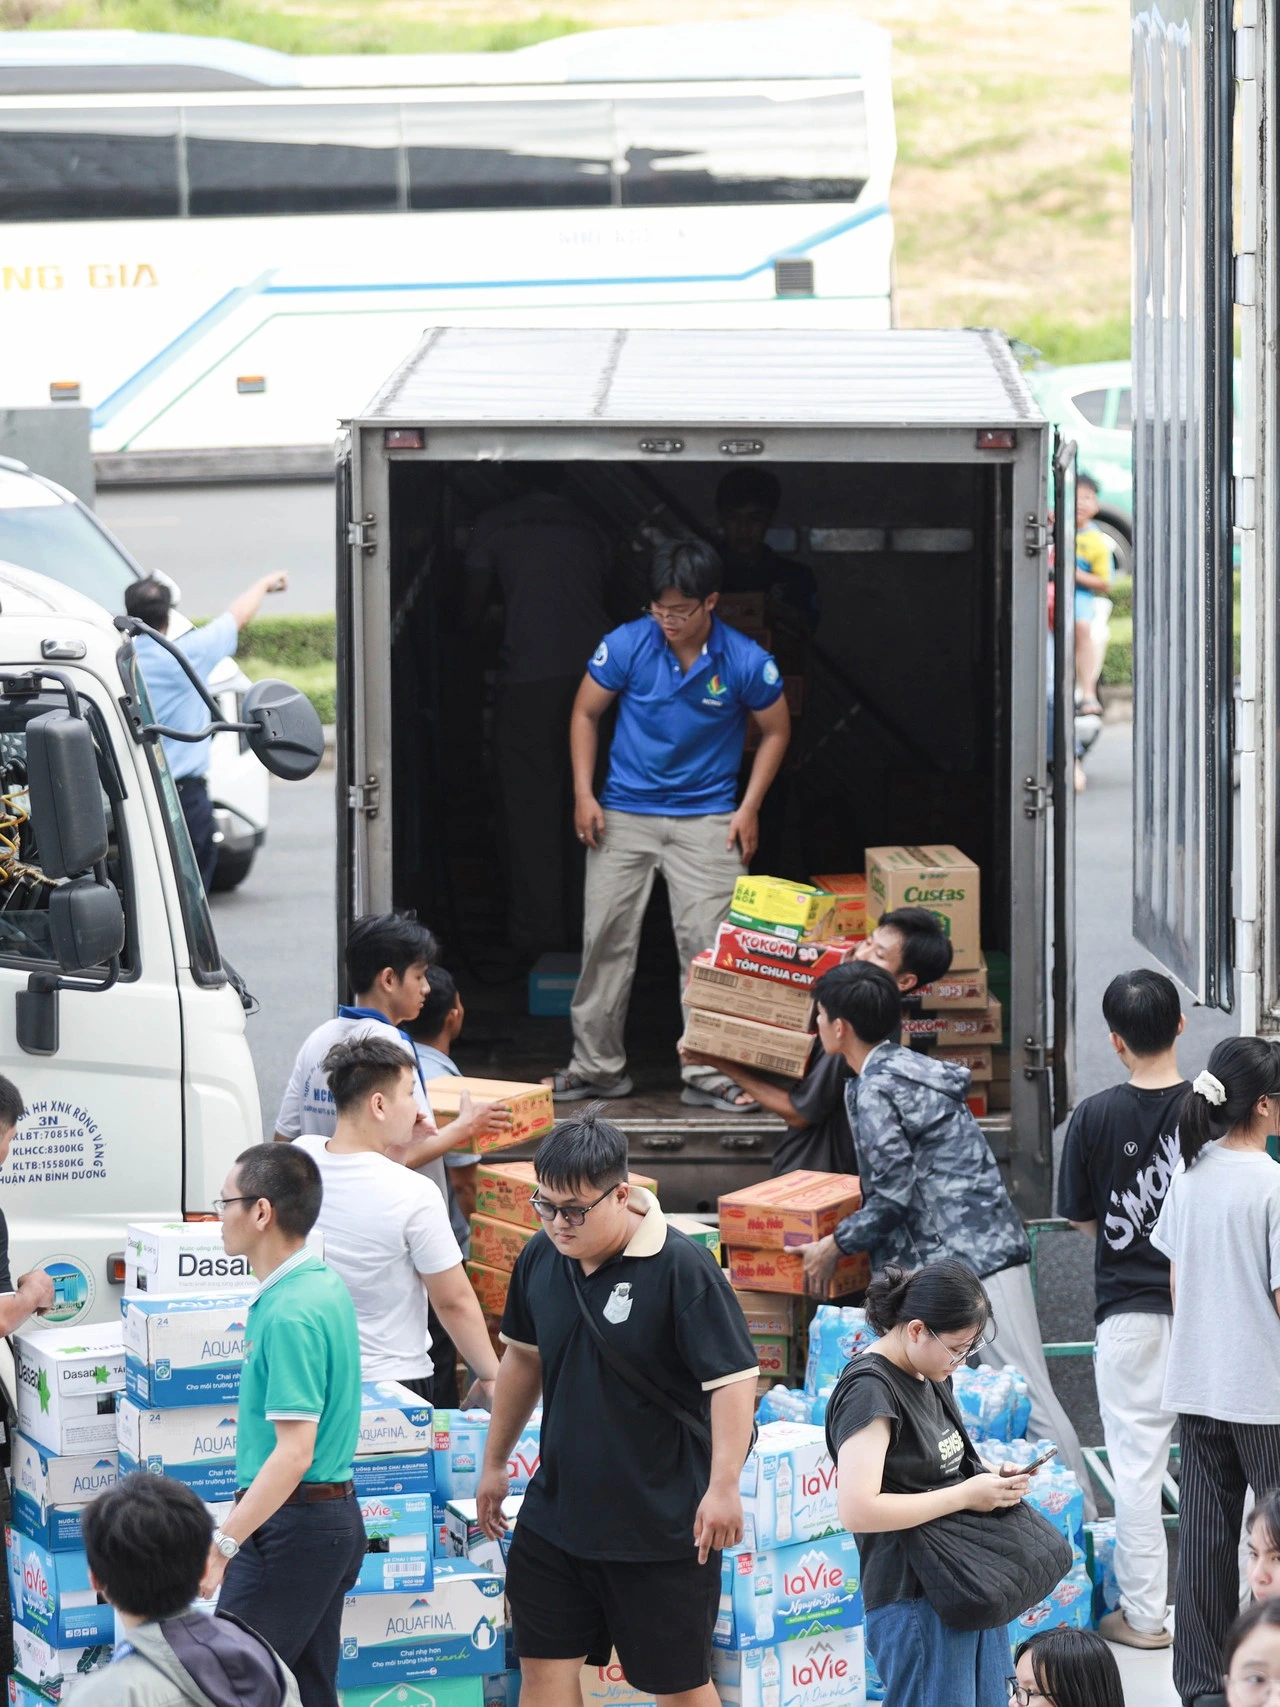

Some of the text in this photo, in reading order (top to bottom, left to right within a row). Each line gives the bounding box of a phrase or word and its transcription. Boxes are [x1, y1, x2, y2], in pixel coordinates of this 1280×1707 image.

[88, 263, 160, 289] GIA
[904, 886, 965, 904] Custas
[739, 932, 818, 961] KOKOMI 90
[735, 957, 815, 985] TÔM CHUA CAY
[50, 1100, 73, 1115] XNK
[38, 1115, 59, 1126] 3N
[12, 1143, 84, 1156] KLHCC:8300KG
[12, 1158, 84, 1171] KLTB:15580KG
[28, 1173, 42, 1183] AN
[45, 1170, 69, 1182] BÌNH
[71, 1169, 107, 1180] DƯƠNG
[178, 1253, 251, 1277] Dasa
[157, 1318, 169, 1326] 24
[201, 1339, 246, 1359] AQUAF
[216, 1373, 231, 1381] Chai
[149, 1414, 161, 1422] 24
[415, 1430, 426, 1438] 24
[193, 1436, 237, 1456] AQUAF
[73, 1473, 117, 1494] AQUAFI
[802, 1464, 838, 1497] laVi
[361, 1504, 391, 1518] aVie
[784, 1562, 844, 1596] laVie
[345, 1597, 356, 1605] 24
[386, 1612, 454, 1637] AQUAFINA
[400, 1649, 415, 1657] Chai
[435, 1646, 470, 1663] xanh
[792, 1653, 848, 1687] laVie
